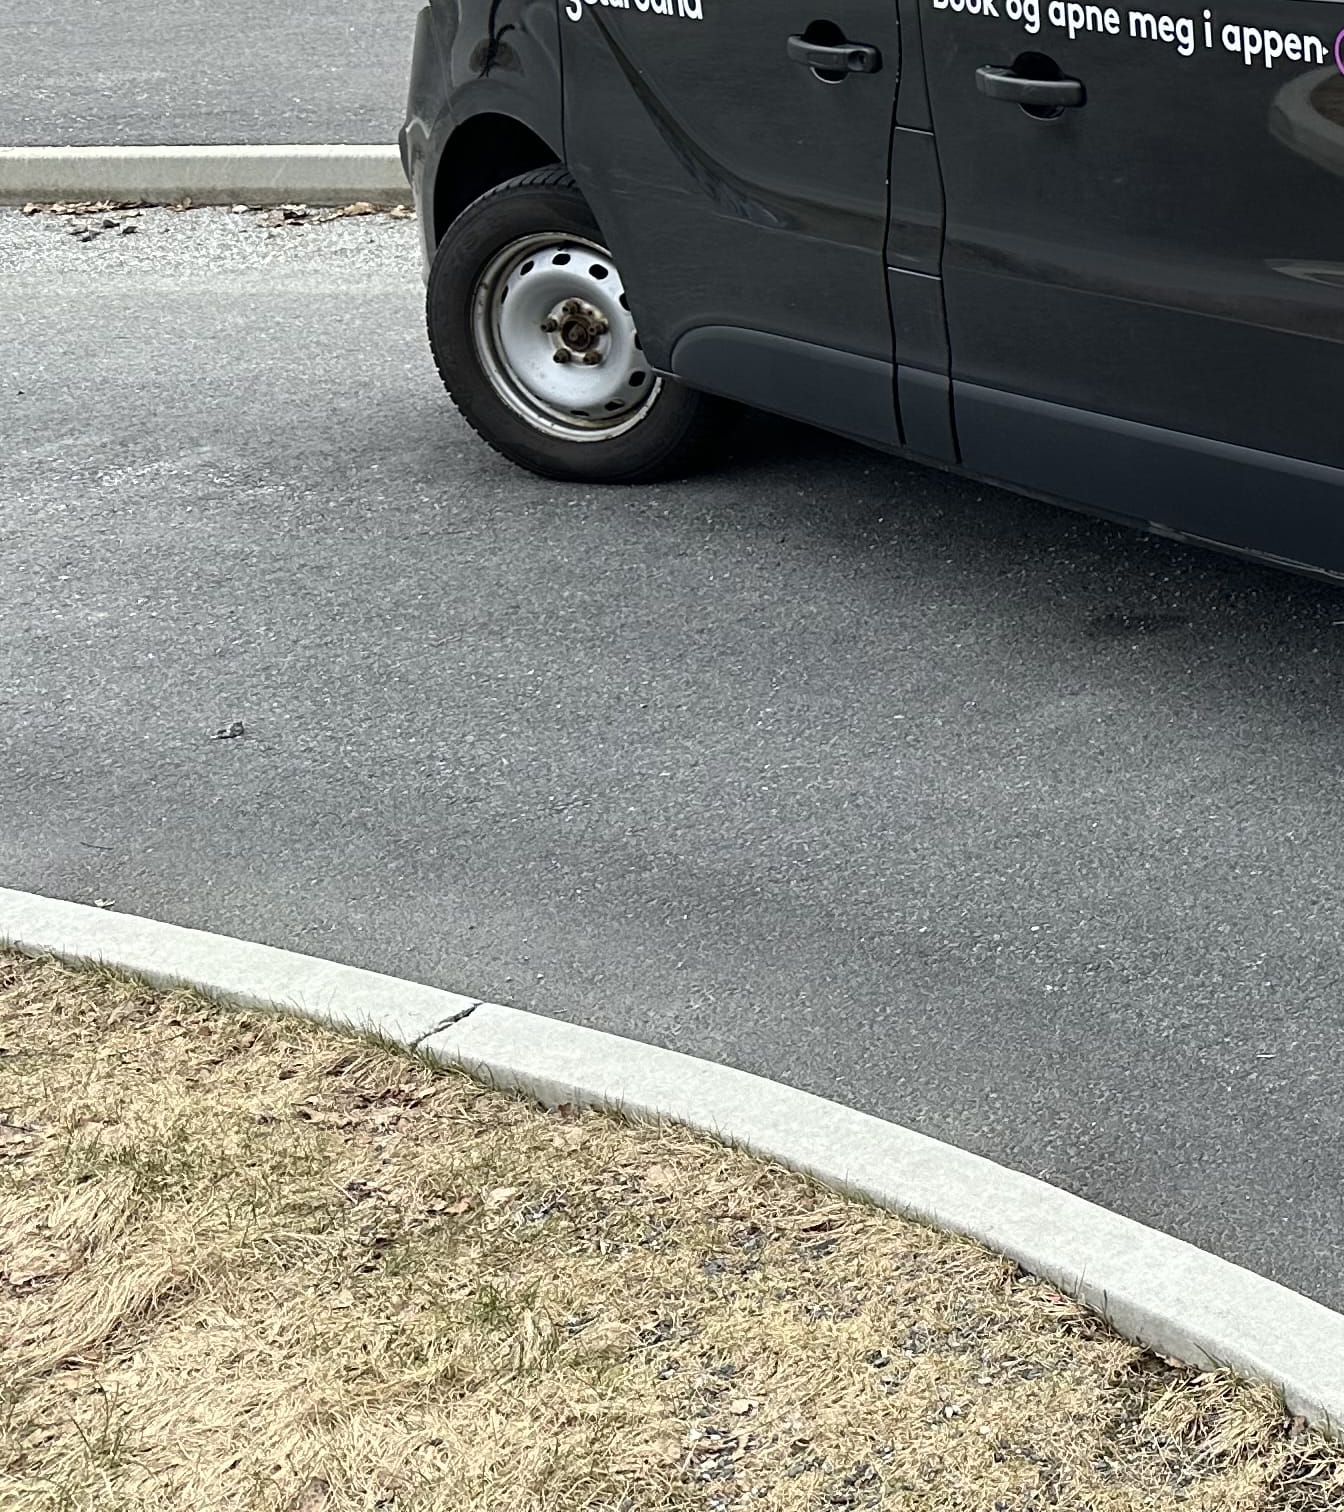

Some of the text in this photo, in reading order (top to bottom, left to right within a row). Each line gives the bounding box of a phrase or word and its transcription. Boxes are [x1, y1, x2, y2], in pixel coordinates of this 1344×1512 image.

[1128, 11, 1195, 57] meg
[1203, 9, 1213, 48] i
[1221, 24, 1324, 69] appen
